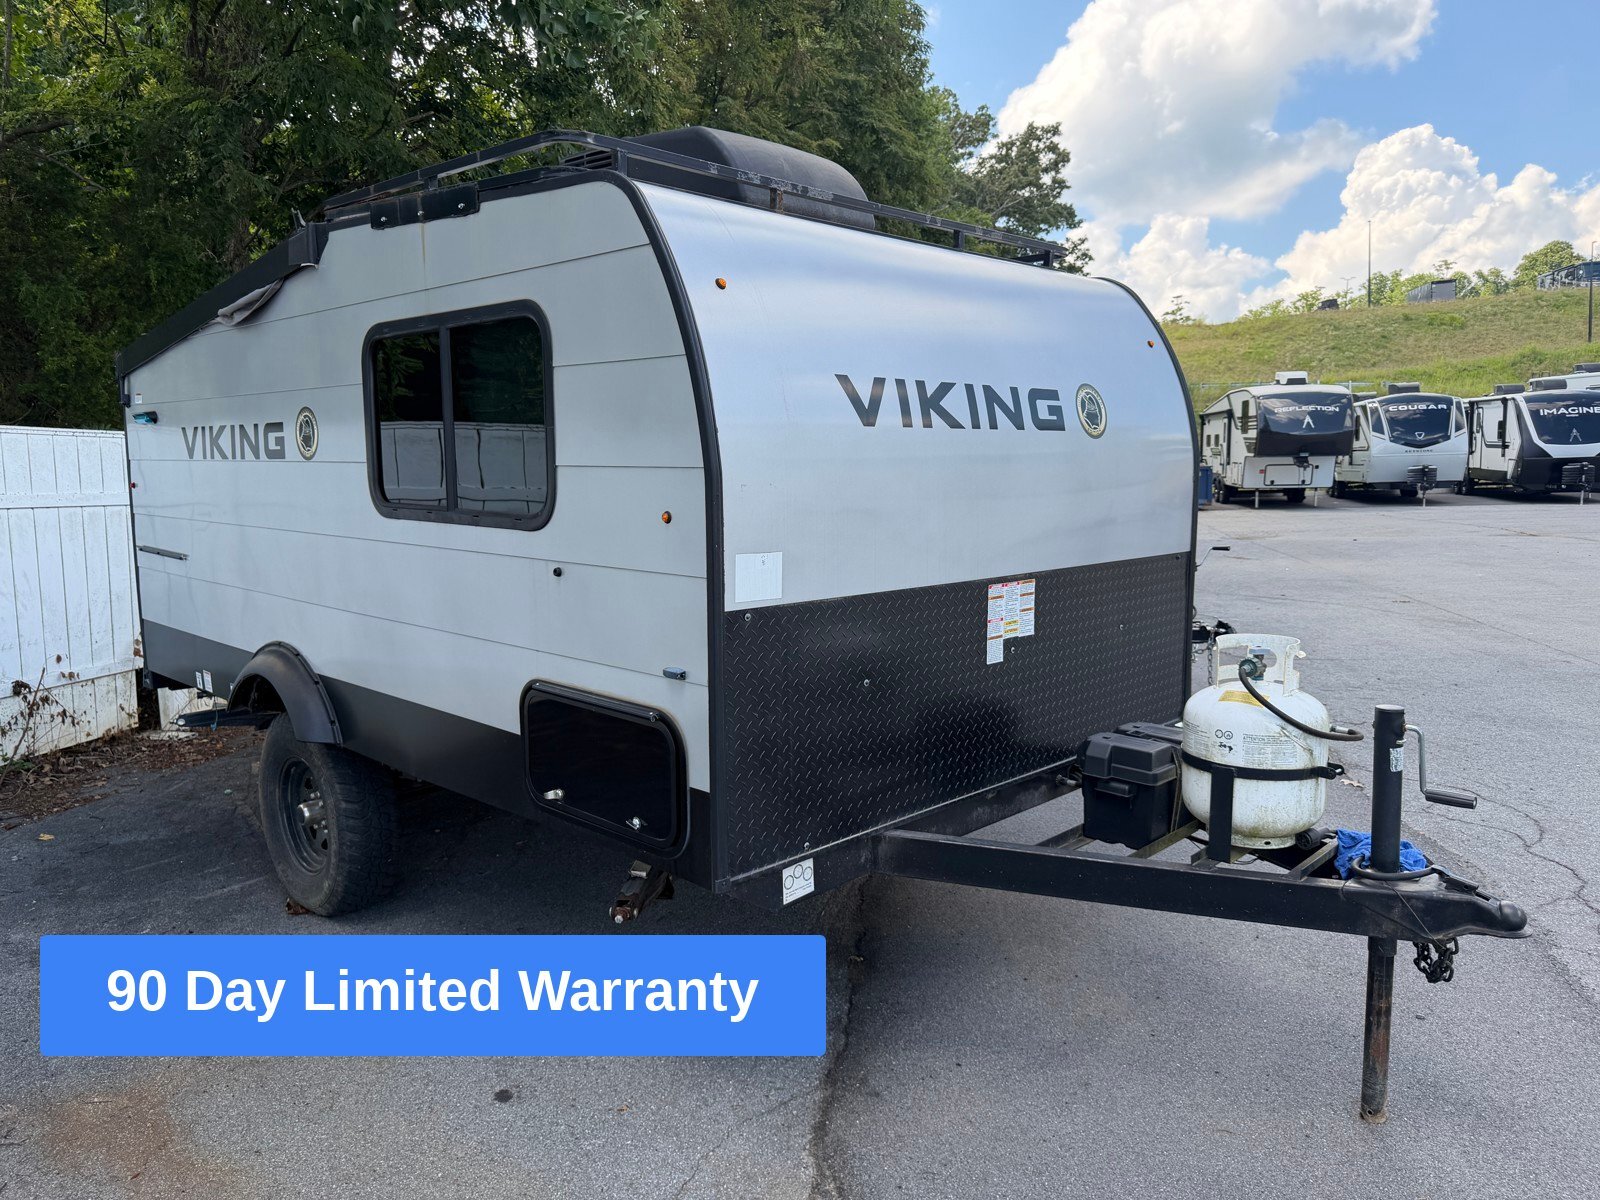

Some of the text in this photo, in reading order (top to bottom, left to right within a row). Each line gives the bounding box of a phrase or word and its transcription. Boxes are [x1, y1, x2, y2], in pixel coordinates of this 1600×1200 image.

[834, 373, 1066, 431] VIKING
[1274, 405, 1340, 413] REFLECTION
[1540, 406, 1600, 416] IMAGINE
[181, 421, 286, 460] VIKING
